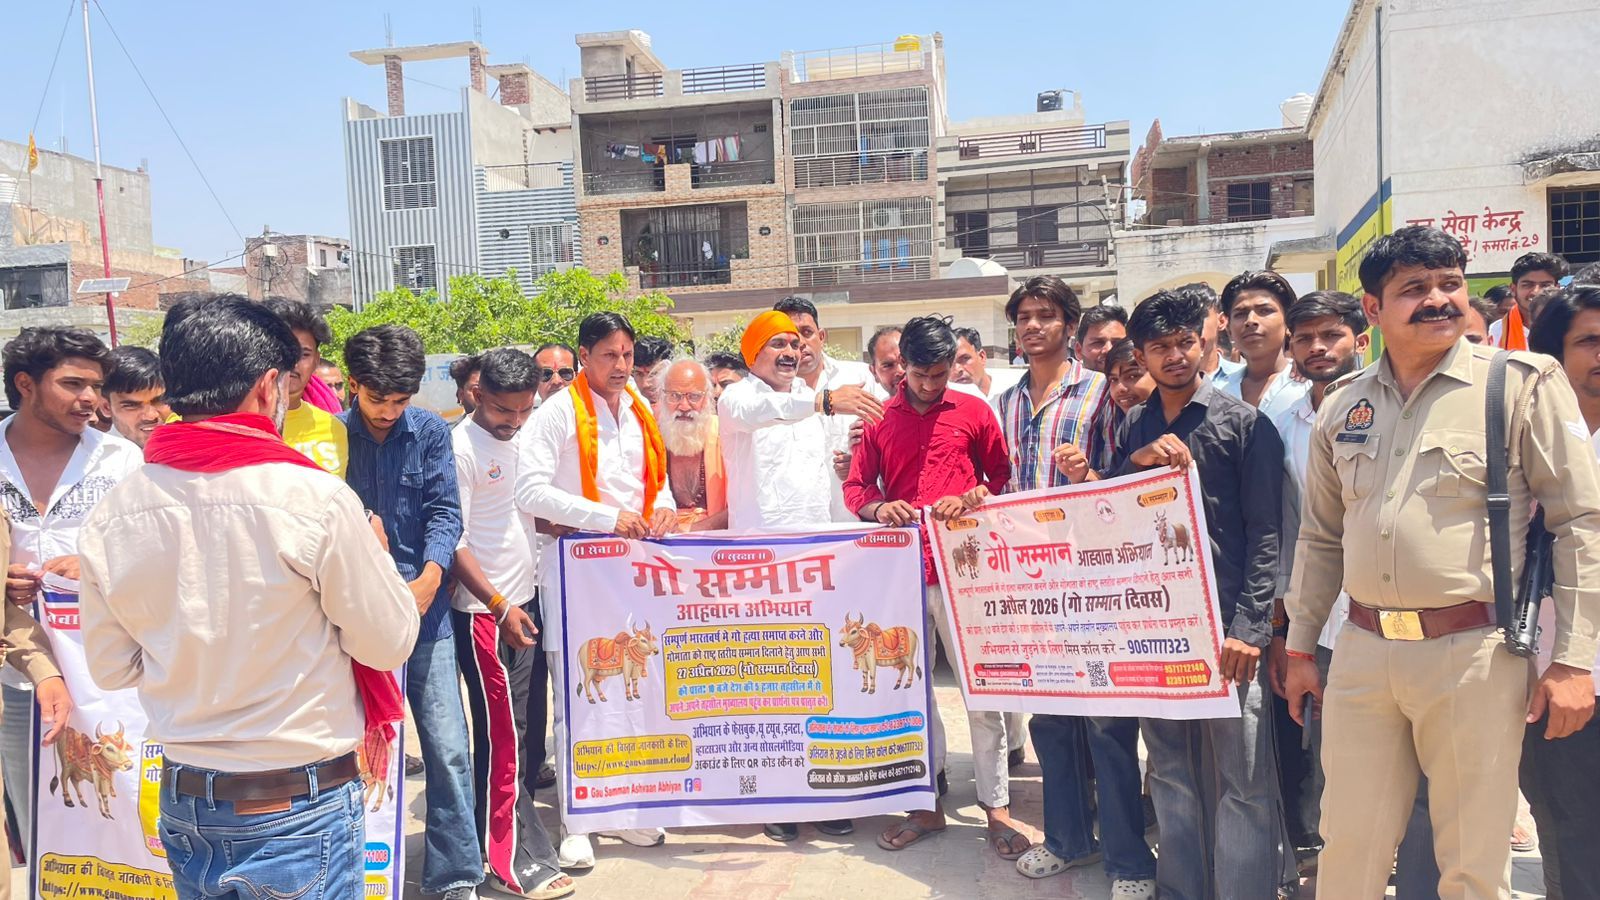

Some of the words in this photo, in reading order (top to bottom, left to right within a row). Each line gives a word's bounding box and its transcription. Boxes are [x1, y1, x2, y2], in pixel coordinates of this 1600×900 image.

[1441, 210, 1478, 234] सेवा
[870, 534, 896, 543] सम्मान
[589, 545, 611, 555] सेवा
[1012, 542, 1072, 579] सम्मान
[1115, 542, 1153, 565] अभियान
[632, 555, 684, 596] गो
[693, 554, 836, 597] सम्मान
[745, 600, 813, 617] अभियान
[984, 601, 996, 616] 27
[1000, 594, 1027, 615] अप्रैल
[1030, 598, 1059, 615] 2026
[1085, 593, 1122, 612] सम्मान
[690, 630, 720, 643] भारतवर्ष
[789, 628, 806, 640] करने
[809, 628, 823, 640] और
[796, 647, 810, 657] आप
[812, 646, 825, 657] सभी
[1128, 638, 1190, 654] 9067777323
[716, 665, 736, 676] 2026
[757, 664, 788, 675] सम्मान
[693, 723, 721, 738] अभियान
[723, 721, 730, 735] के
[728, 741, 741, 753] और
[747, 759, 758, 769] QR
[761, 756, 775, 768] कोड
[604, 785, 630, 797] Samman
